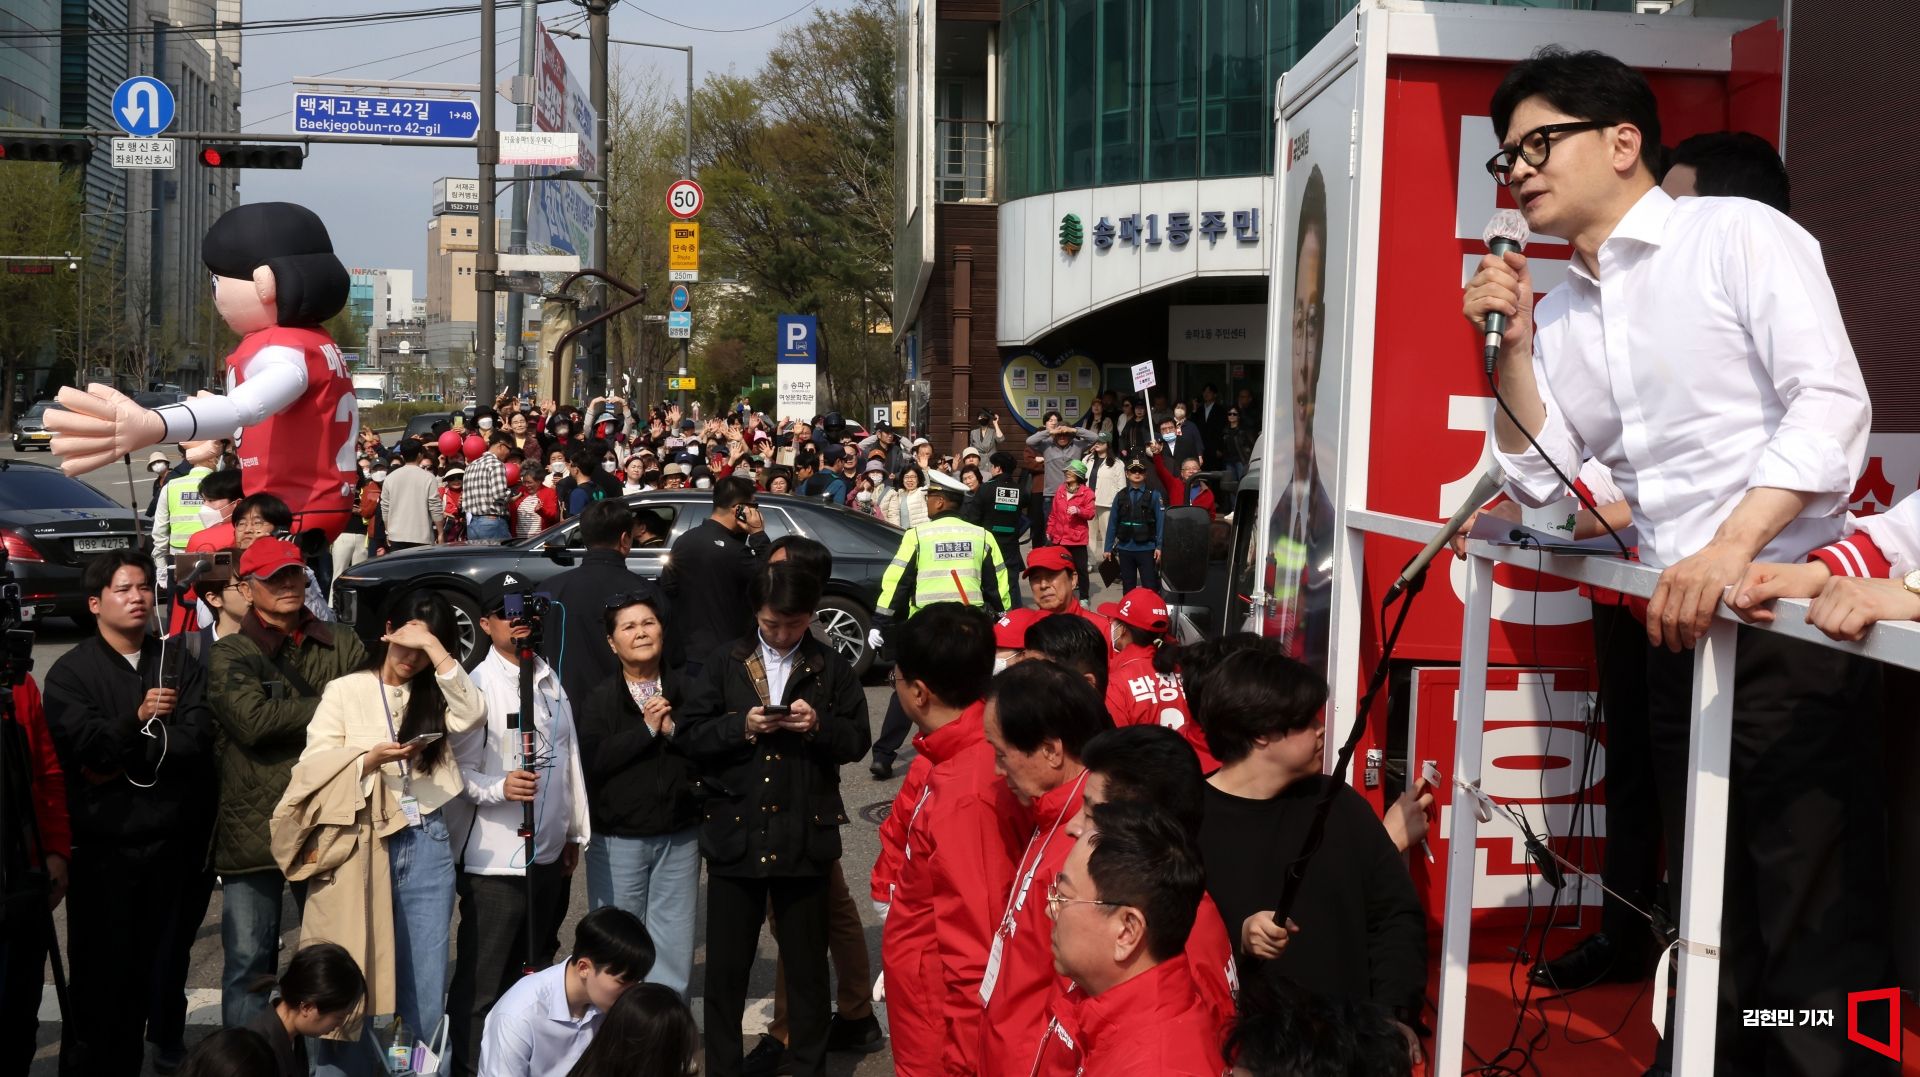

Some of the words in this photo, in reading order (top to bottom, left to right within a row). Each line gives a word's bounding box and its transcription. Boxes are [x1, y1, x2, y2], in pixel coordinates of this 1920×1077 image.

[300, 97, 430, 121] 백제고분로42길
[299, 118, 402, 134] Baekjegobun-ro
[404, 122, 441, 136] 42-gil
[115, 142, 172, 153] 보행신호시
[115, 154, 172, 165] 좌회전신호시
[674, 191, 696, 208] 50
[672, 243, 696, 253] 단속중
[674, 271, 693, 280] 250m
[787, 322, 808, 350] P
[790, 381, 811, 390] 송파구
[998, 489, 1017, 498] 경찰
[101, 539, 125, 550] 4275
[936, 541, 972, 552] 교통경찰
[1122, 600, 1132, 612] 2
